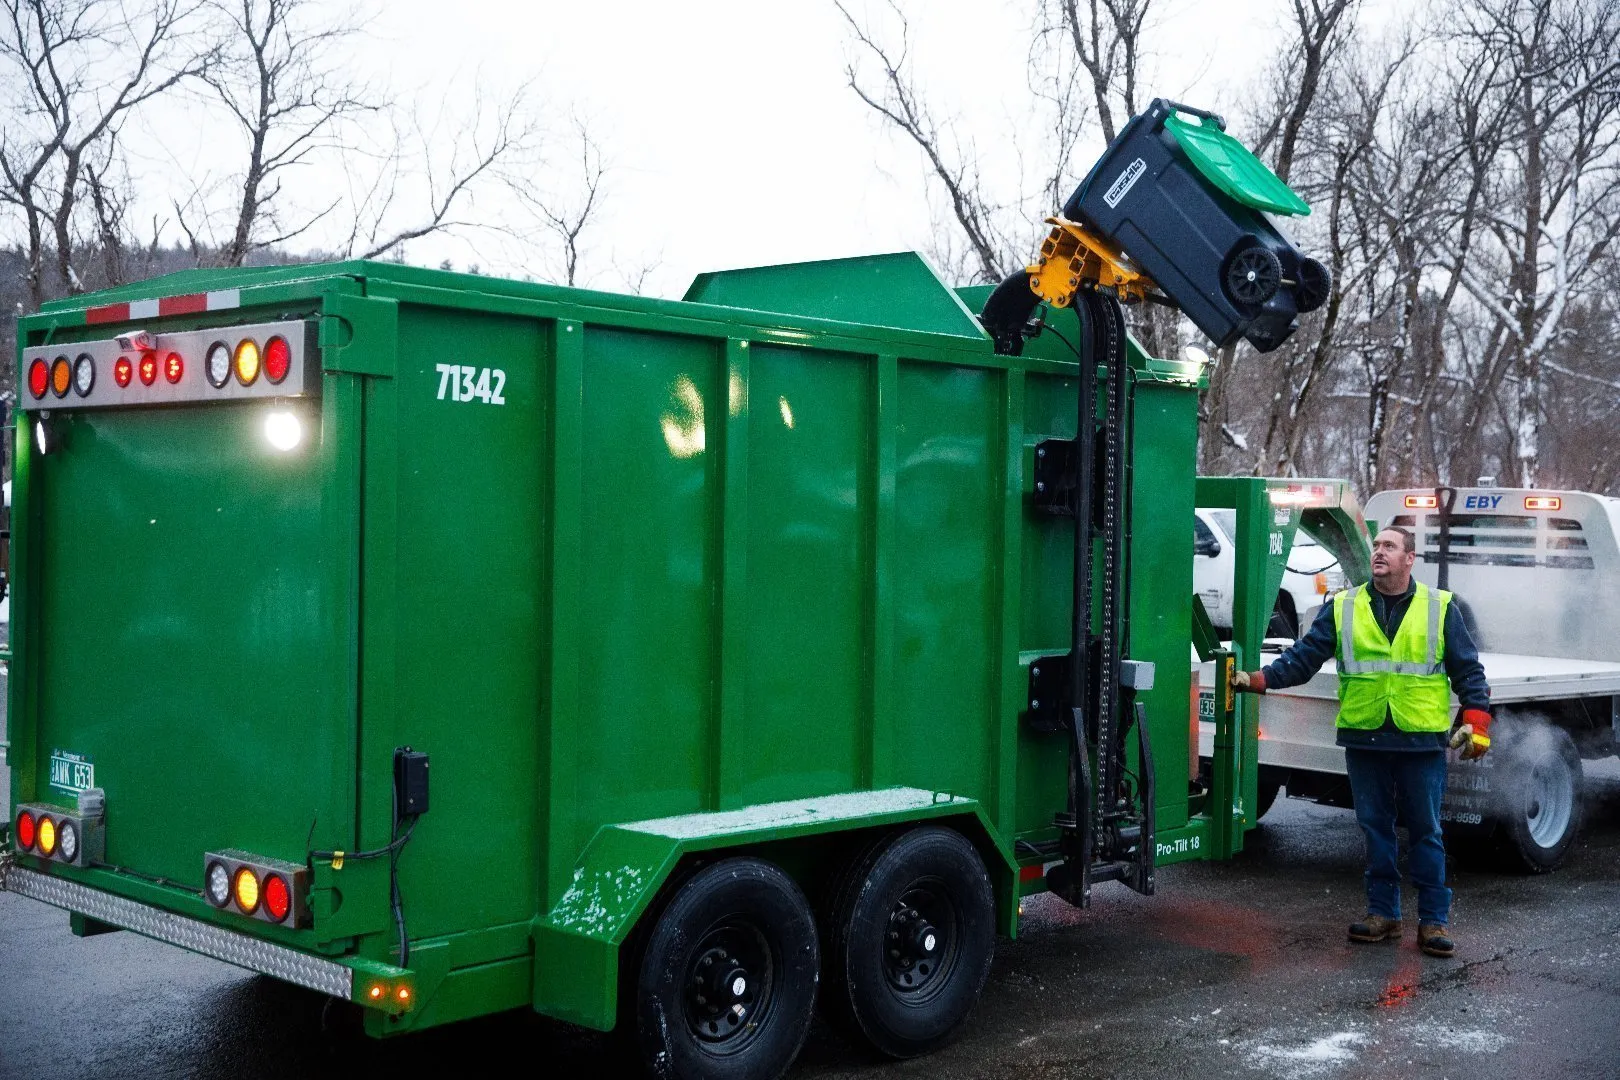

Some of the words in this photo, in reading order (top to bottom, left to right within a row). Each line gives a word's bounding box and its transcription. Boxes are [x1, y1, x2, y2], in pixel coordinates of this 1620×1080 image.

[436, 363, 506, 405] 71342
[1465, 495, 1503, 509] EBY
[74, 764, 91, 789] 653
[1156, 838, 1189, 857] Pro-Tilt
[1190, 835, 1200, 850] 18
